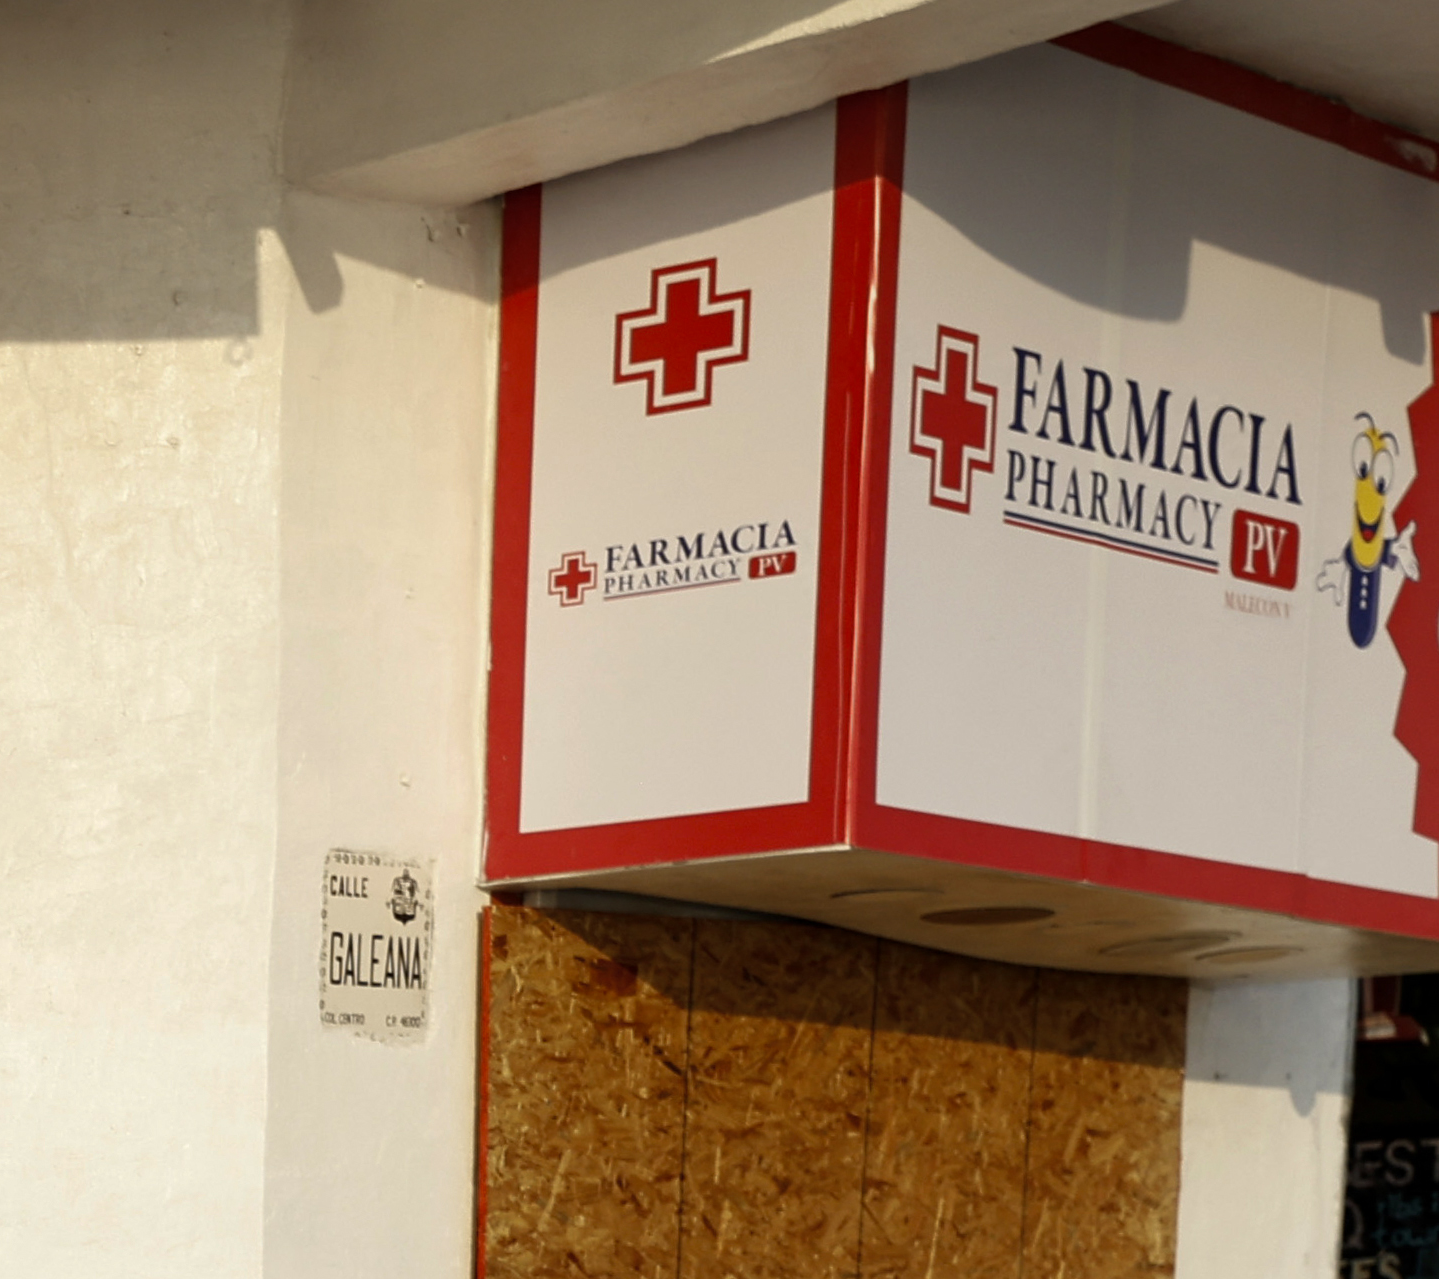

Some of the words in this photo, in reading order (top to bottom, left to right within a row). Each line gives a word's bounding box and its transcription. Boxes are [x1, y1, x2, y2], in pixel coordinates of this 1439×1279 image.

[1009, 346, 1303, 506] FARMACIA
[1004, 449, 1223, 551] PHARMACY
[1243, 519, 1290, 579] PV
[603, 558, 740, 594] PHARMACY
[758, 554, 788, 577] PV
[604, 519, 797, 573] FARMACIA
[330, 874, 370, 899] CALLE
[329, 931, 423, 990] GALEANA
